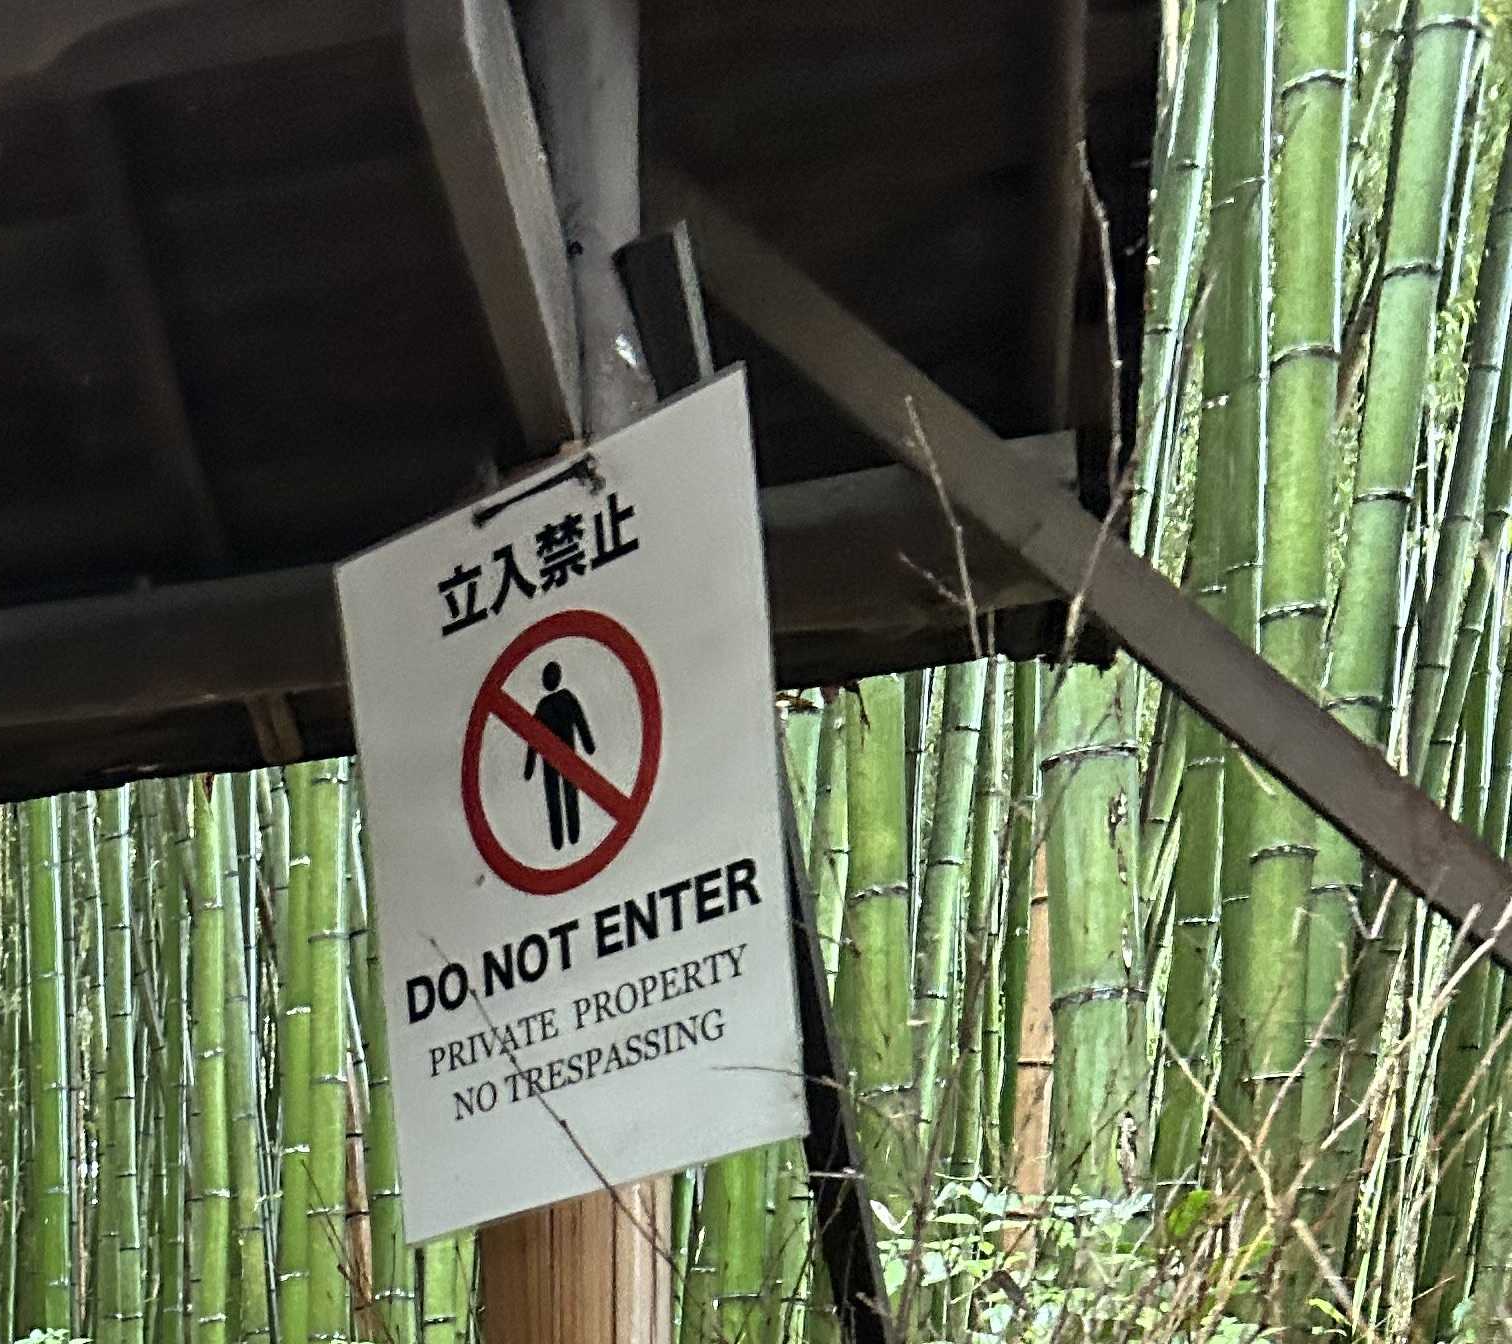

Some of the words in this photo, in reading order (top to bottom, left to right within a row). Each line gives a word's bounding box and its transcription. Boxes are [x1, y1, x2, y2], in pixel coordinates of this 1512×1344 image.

[438, 492, 639, 637] 立入禁止
[406, 962, 468, 1024] DO
[482, 920, 581, 1000] NOT
[594, 858, 761, 958] ENTER
[428, 1007, 560, 1077] PRIVATE
[573, 943, 750, 1033] PROPERTY
[453, 1083, 498, 1121] NO
[504, 1009, 726, 1104] TRESPASSING
